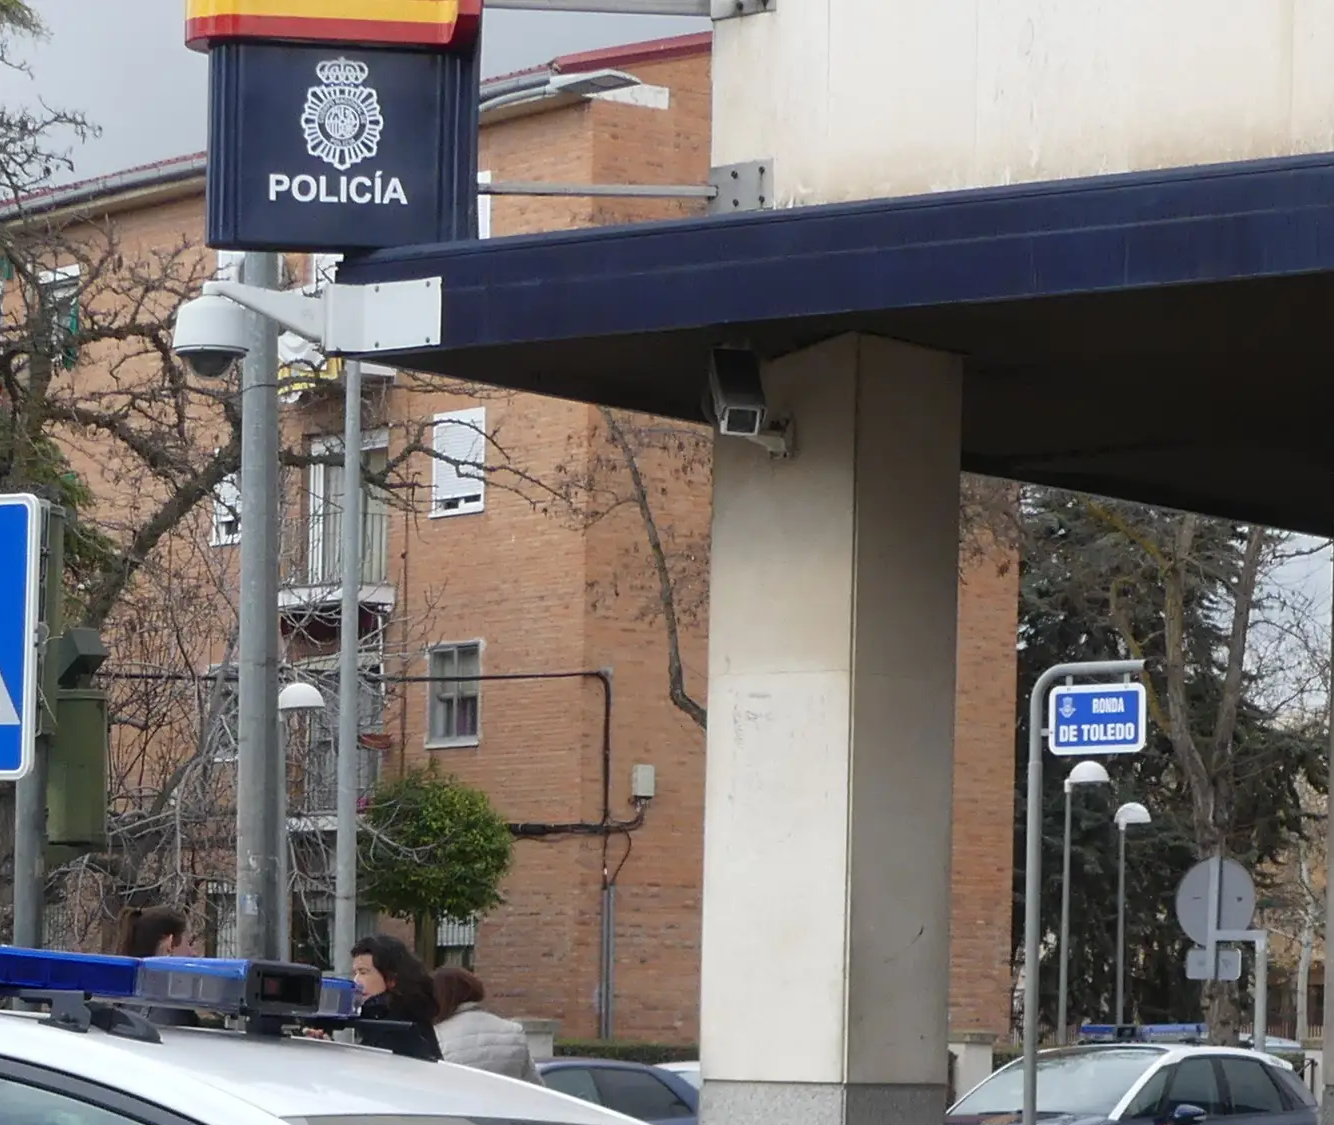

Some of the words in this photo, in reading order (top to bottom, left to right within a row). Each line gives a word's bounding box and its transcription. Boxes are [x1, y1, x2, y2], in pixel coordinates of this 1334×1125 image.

[268, 171, 409, 205] POLICÍA
[1092, 697, 1125, 714] RONDA
[1059, 725, 1078, 743] DE
[1081, 722, 1136, 742] TOLEDO
